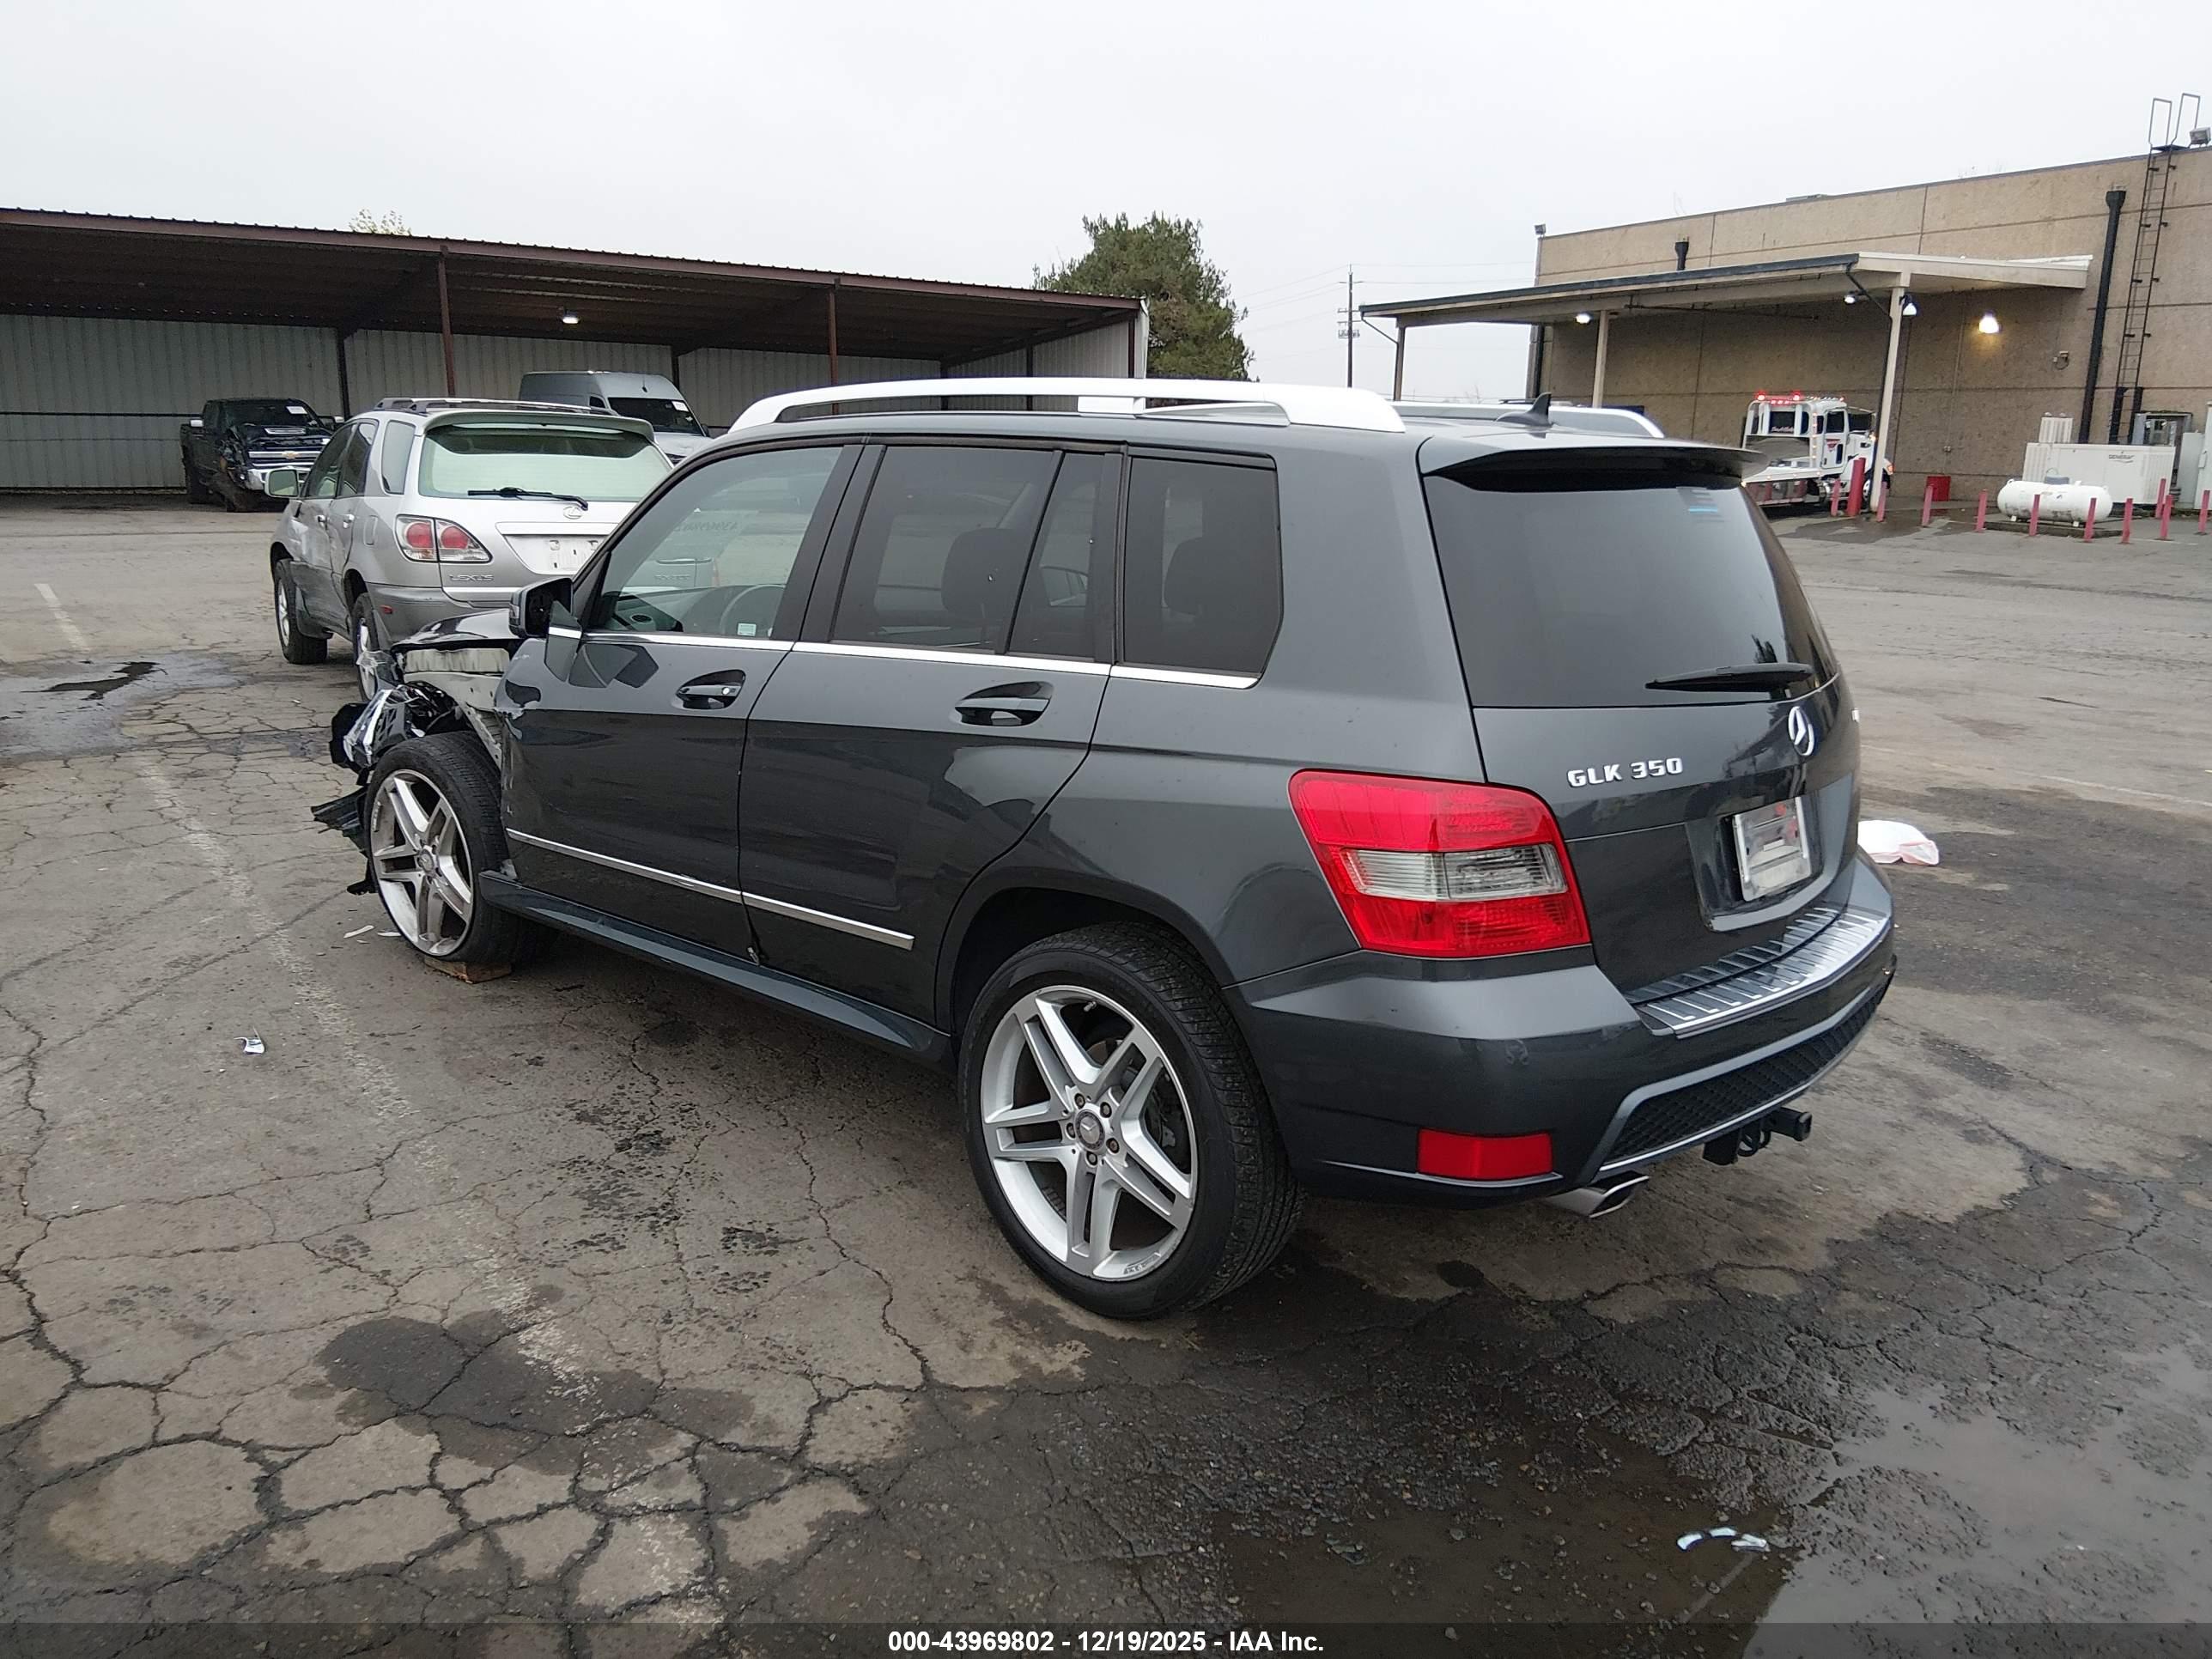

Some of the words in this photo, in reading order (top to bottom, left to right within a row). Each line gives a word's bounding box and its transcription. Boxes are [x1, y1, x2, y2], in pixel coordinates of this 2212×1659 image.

[449, 574, 495, 582] LEXUS
[1567, 763, 1622, 787] GLK
[1630, 757, 1683, 779] 350
